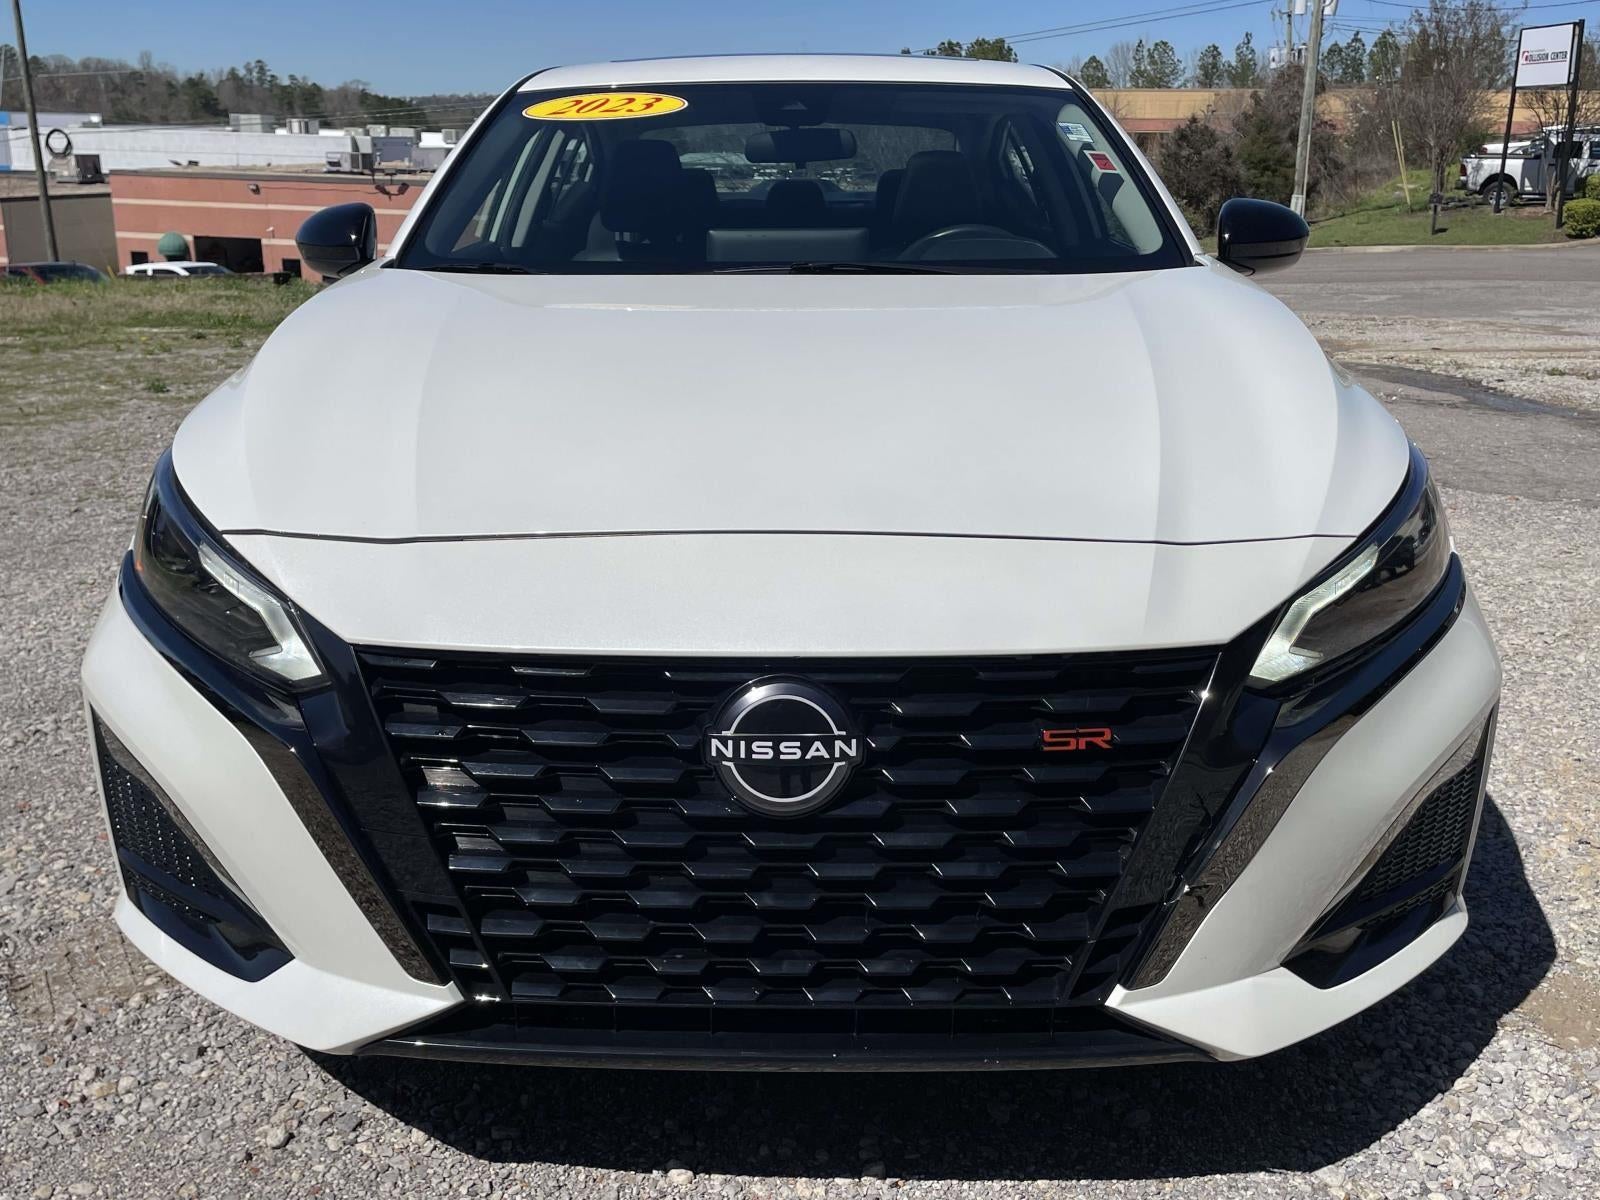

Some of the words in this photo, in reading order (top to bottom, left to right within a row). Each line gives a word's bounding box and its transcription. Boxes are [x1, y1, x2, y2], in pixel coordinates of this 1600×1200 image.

[1551, 51, 1568, 60] CENTER
[546, 97, 663, 116] 2023
[711, 738, 857, 760] NISSAN
[1043, 728, 1112, 752] SR
